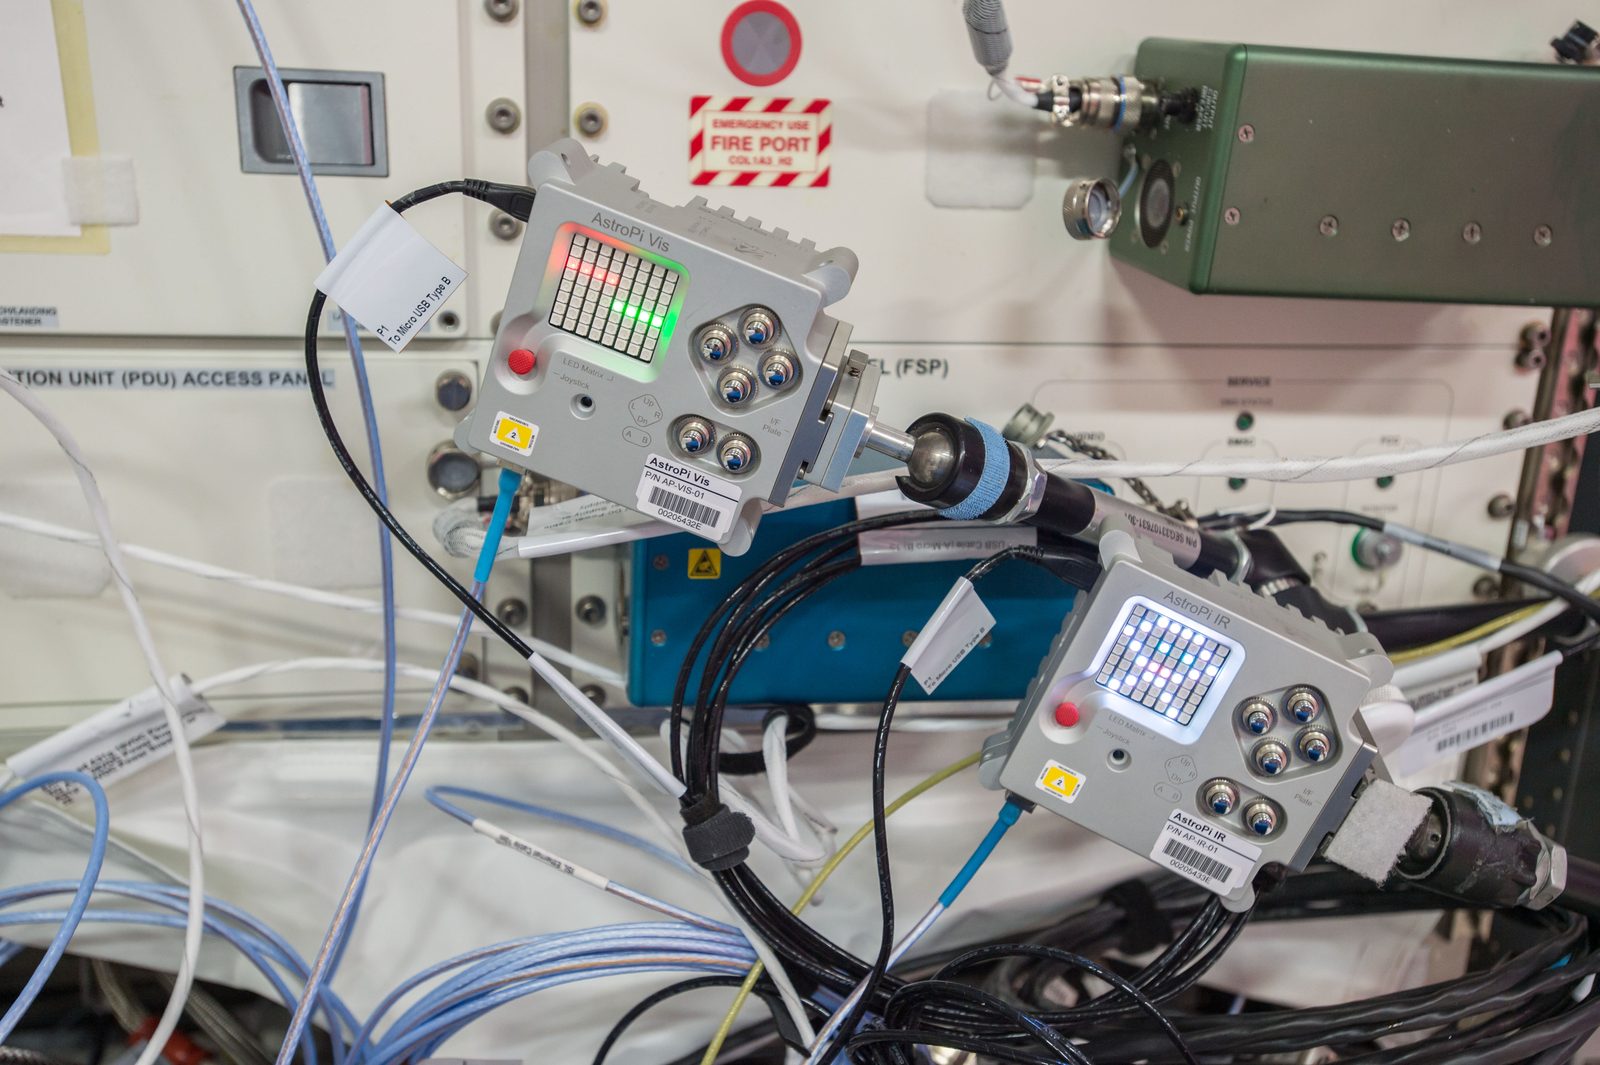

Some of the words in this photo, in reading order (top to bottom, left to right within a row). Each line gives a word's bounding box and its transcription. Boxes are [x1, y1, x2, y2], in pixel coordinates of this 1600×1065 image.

[712, 119, 783, 130] EMERGENCY
[787, 121, 809, 130] USE
[711, 136, 753, 151] FIRE
[760, 136, 811, 152] PORT
[591, 212, 645, 242] AstroPi
[650, 232, 670, 252] Vis
[388, 335, 401, 345] To
[396, 316, 417, 336] Micro
[413, 299, 431, 317] USB
[426, 283, 446, 302] Type
[441, 276, 451, 286] B
[376, 324, 389, 336] P1
[562, 358, 580, 370] LED
[581, 364, 604, 379] Matrix
[896, 358, 949, 379] (FSP)
[8, 370, 62, 386] TION
[69, 371, 115, 387] UNIT
[122, 371, 176, 389] (PDU)
[182, 371, 262, 387] ACCESS
[269, 371, 333, 386] PANL
[560, 373, 590, 390] Joystick
[643, 397, 654, 408] Up
[637, 415, 648, 425] Dn
[763, 424, 782, 436] Plate
[511, 431, 517, 439] 2
[626, 430, 632, 438] A
[642, 436, 648, 444] B
[649, 457, 691, 479] AstroPi
[694, 473, 710, 486] Vis
[644, 471, 661, 482] P/N
[662, 478, 705, 500] AP-VIS-01
[657, 508, 702, 531] 00205432E
[1124, 512, 1185, 543] SEG33107631-30
[1163, 591, 1214, 620] AstroPi
[1213, 614, 1231, 629] IR
[936, 664, 953, 681] Micro
[952, 649, 966, 663] USB
[965, 634, 980, 649] Type
[924, 677, 932, 686] P1
[1174, 812, 1214, 836] AstroPi
[1214, 830, 1227, 842] IR
[1167, 824, 1182, 836] P/N
[1183, 832, 1218, 854] AP-IR-01
[1169, 859, 1212, 884] 00205433E
